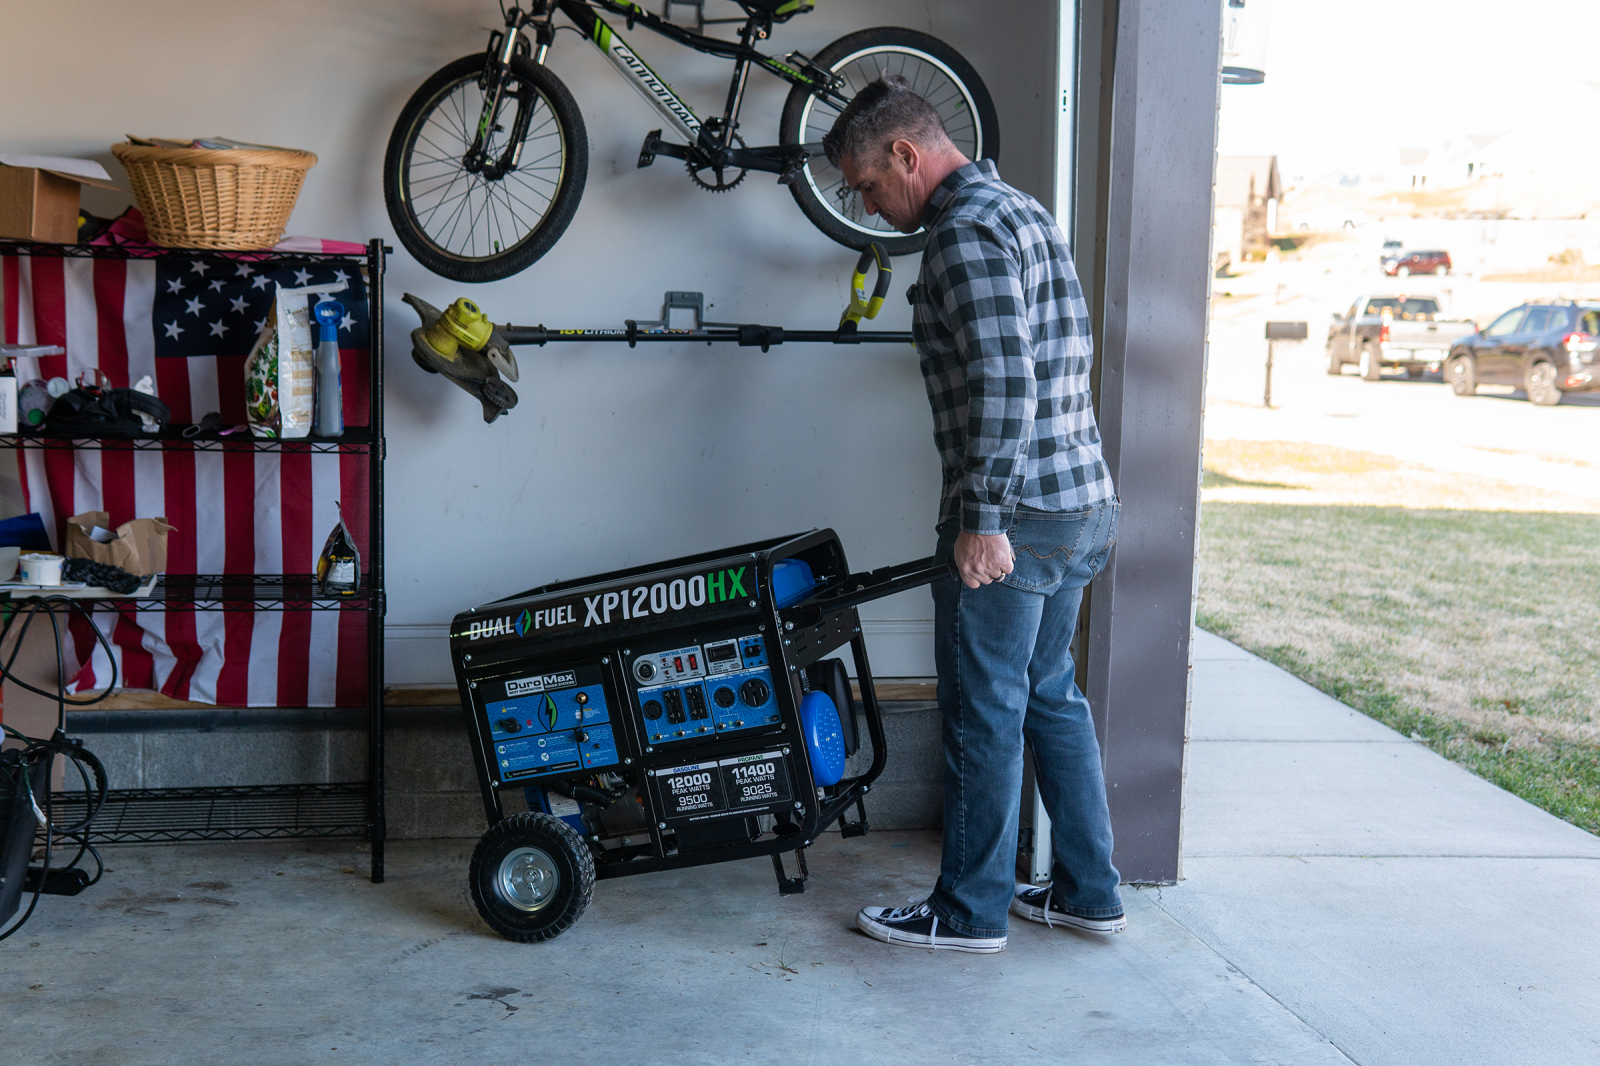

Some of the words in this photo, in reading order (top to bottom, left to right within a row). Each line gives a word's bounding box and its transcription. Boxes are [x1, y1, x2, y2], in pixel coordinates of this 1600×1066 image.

[469, 616, 514, 641] DUAL
[535, 604, 576, 629] FUEL
[583, 566, 748, 628] XP12000HX
[659, 650, 680, 658] CONTROL
[681, 647, 699, 655] CENTER
[737, 755, 764, 763] PROPANE
[672, 765, 700, 773] GASOLINE
[731, 762, 776, 779] 11400
[667, 772, 712, 789] 12000
[735, 777, 753, 786] PEAK
[753, 774, 775, 783] WATTS
[671, 787, 688, 795] PEAK
[688, 784, 711, 793] WATTS
[742, 783, 772, 797] 9025
[678, 793, 708, 806] 9500
[740, 794, 761, 802] RUNNING
[760, 792, 778, 800] WATTS
[676, 804, 697, 812] RUNNING
[696, 801, 714, 809] WATTS
